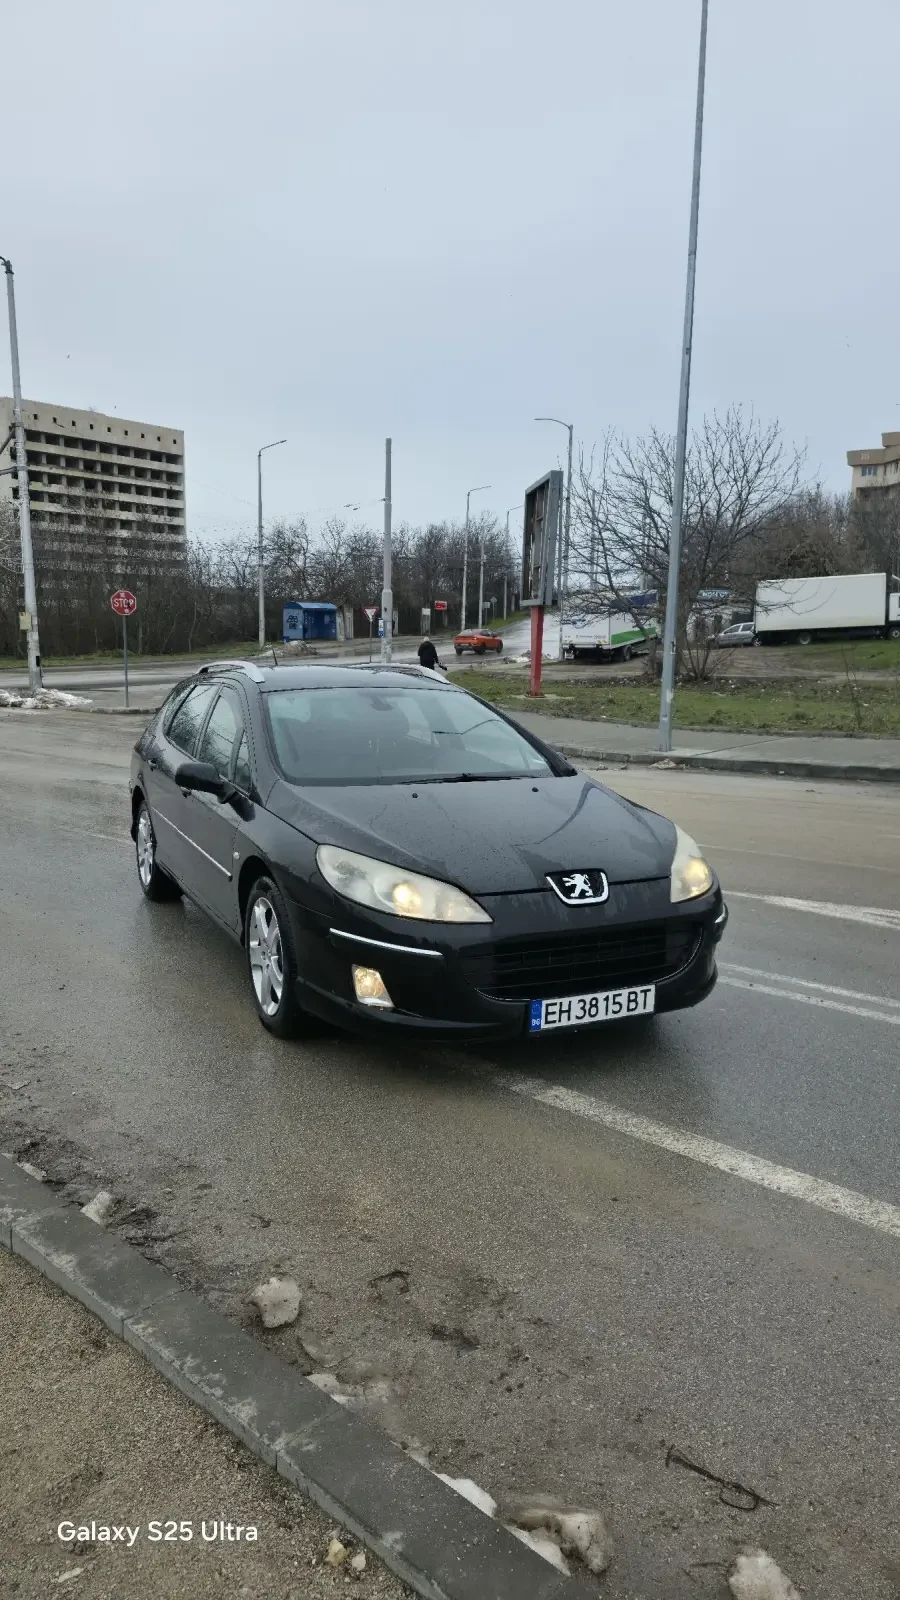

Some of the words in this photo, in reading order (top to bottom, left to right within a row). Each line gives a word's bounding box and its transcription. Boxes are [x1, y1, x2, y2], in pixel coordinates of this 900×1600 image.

[113, 598, 134, 608] STOP
[544, 1000, 572, 1025] EH
[575, 993, 623, 1020] 3815
[626, 988, 652, 1013] BT
